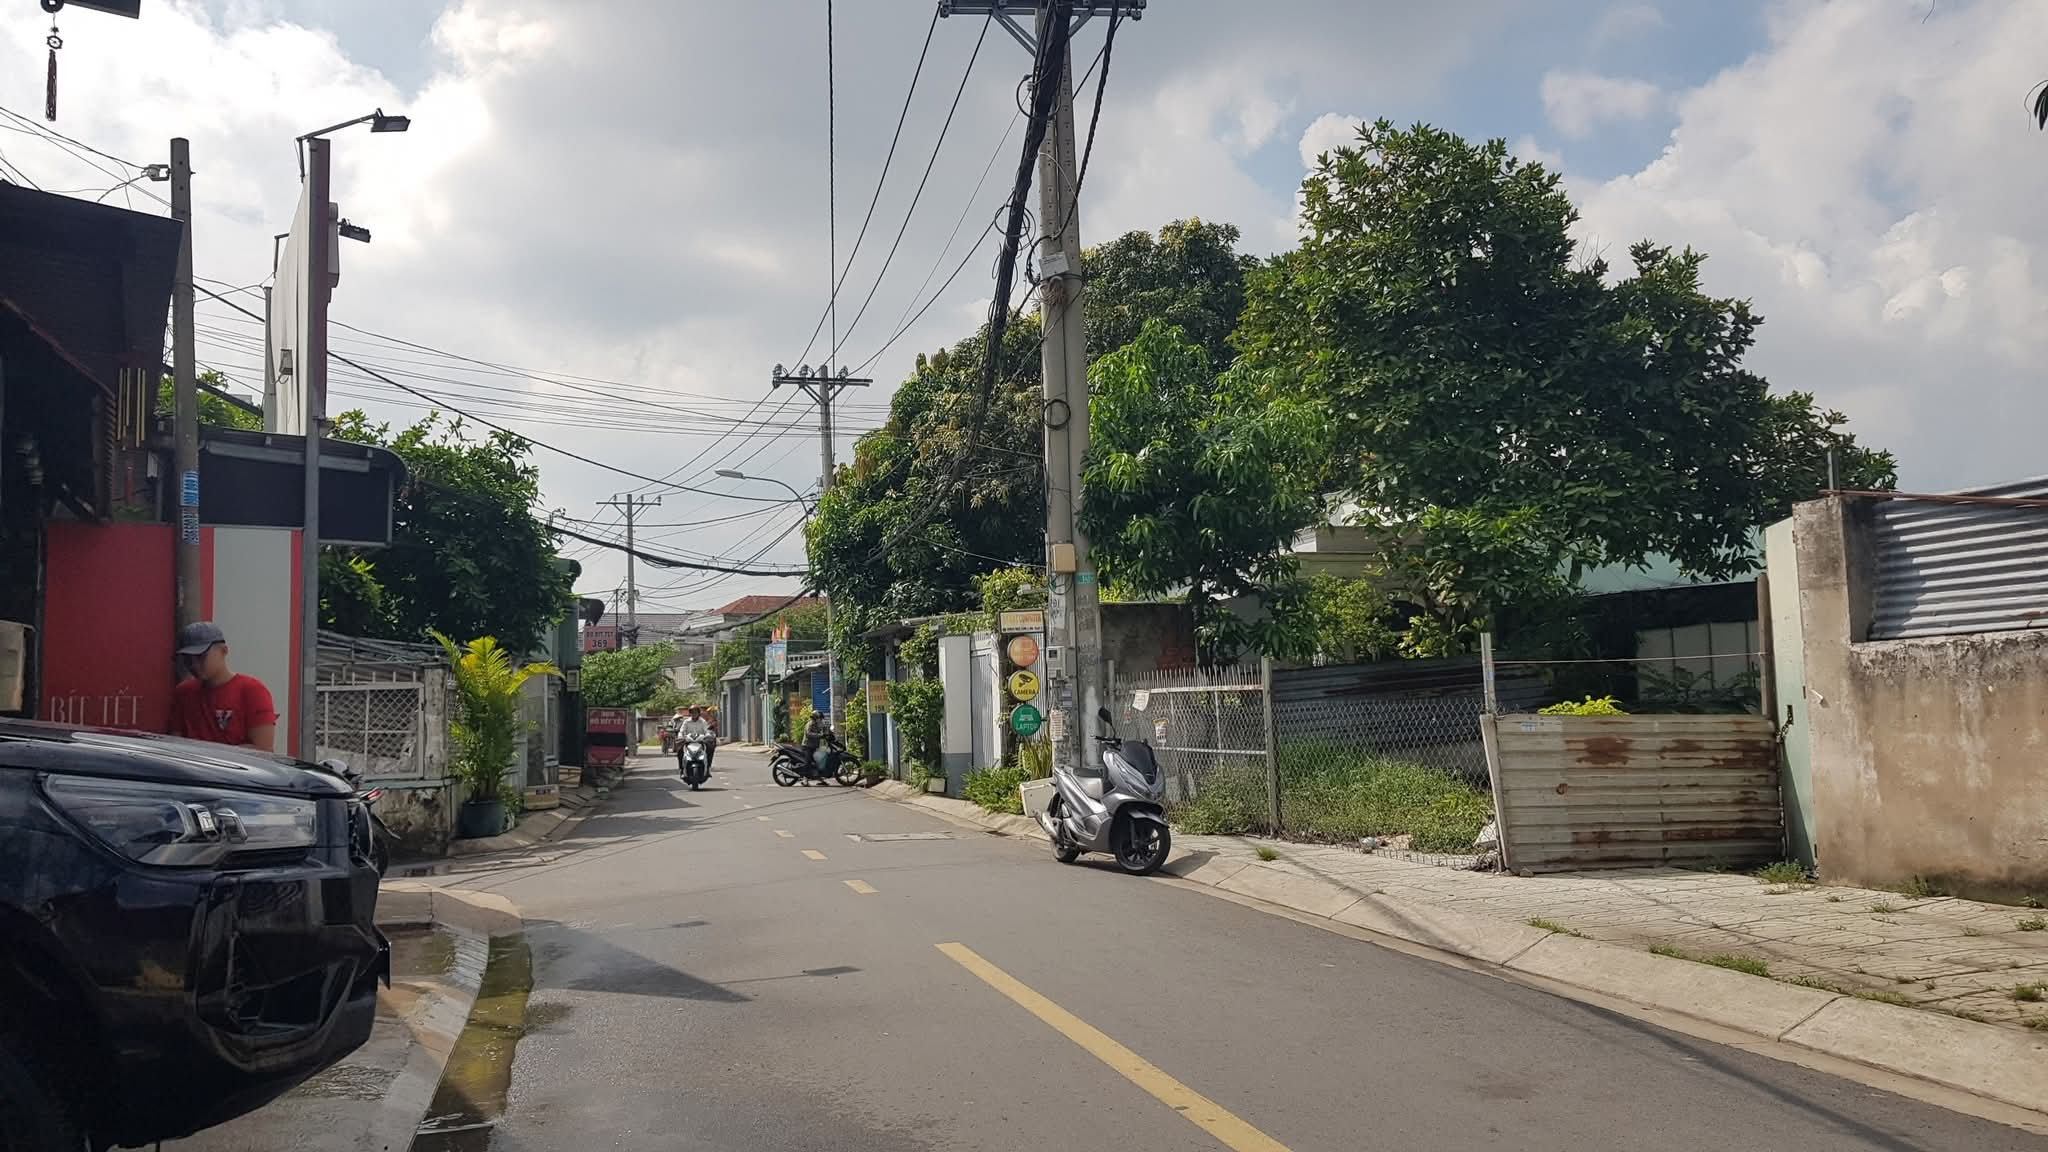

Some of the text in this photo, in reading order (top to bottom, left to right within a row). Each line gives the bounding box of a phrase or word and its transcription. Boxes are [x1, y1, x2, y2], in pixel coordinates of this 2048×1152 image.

[592, 639, 608, 648] 369
[49, 685, 143, 727] BÍT TẾT
